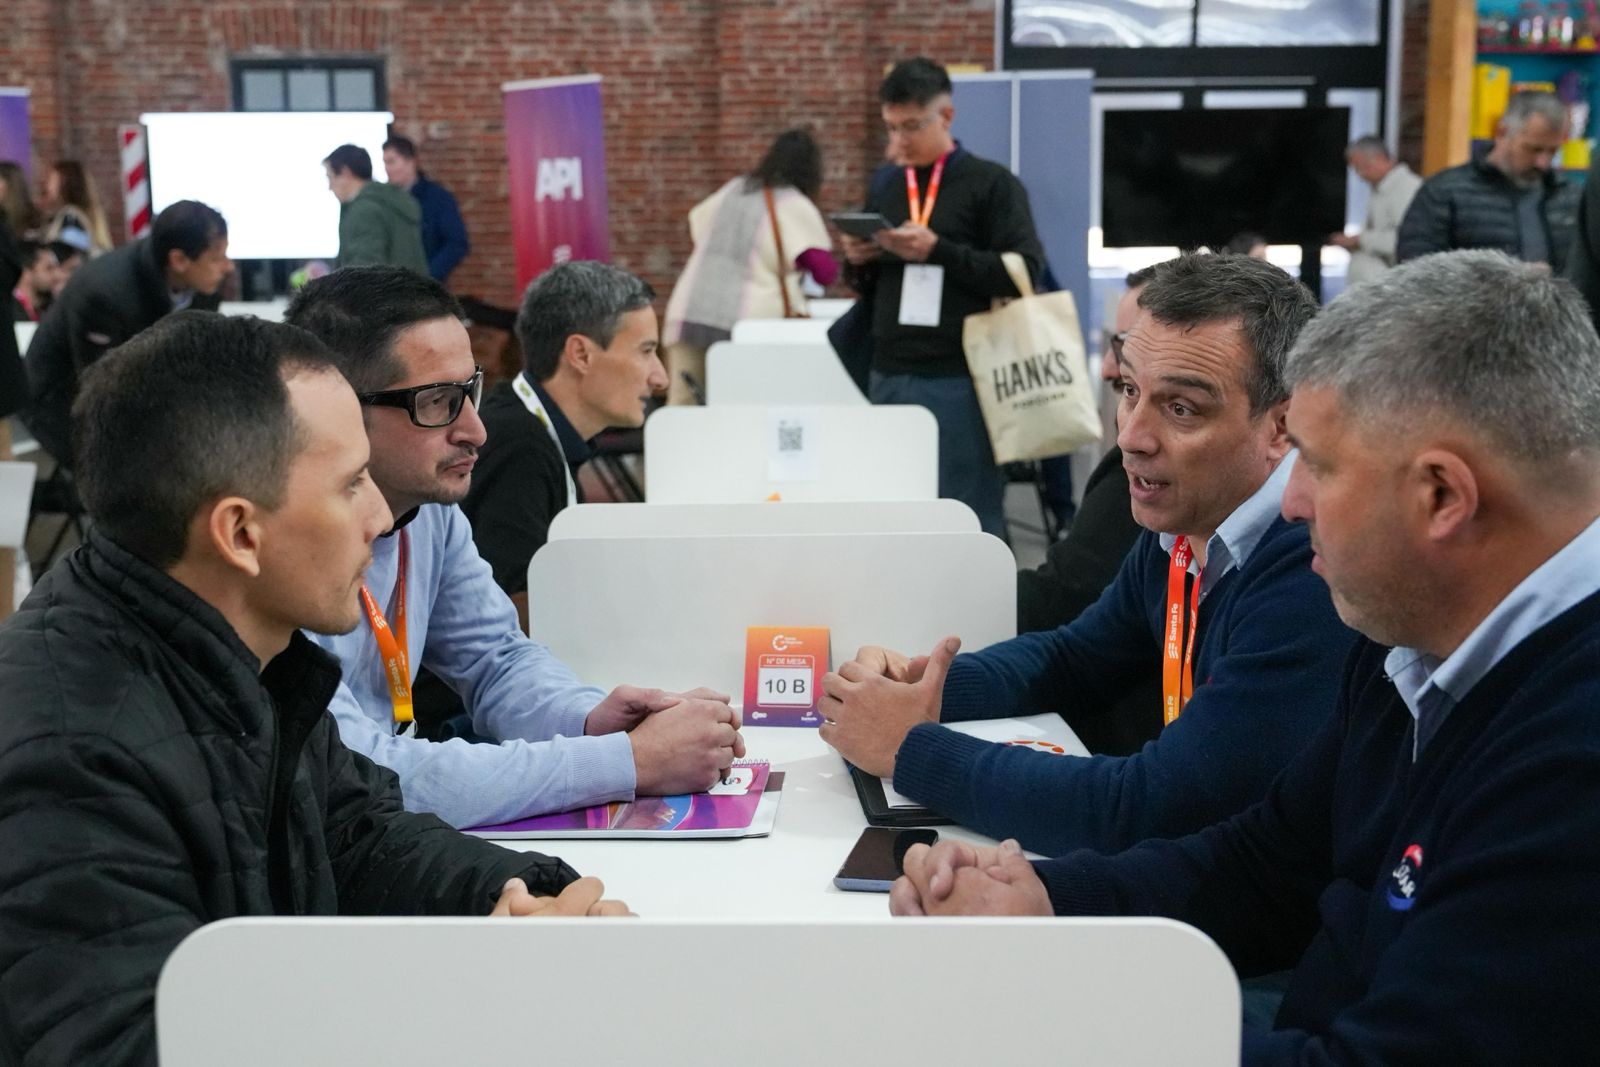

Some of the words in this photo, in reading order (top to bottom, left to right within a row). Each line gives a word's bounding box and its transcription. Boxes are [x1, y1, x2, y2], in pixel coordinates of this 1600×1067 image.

[534, 157, 583, 202] API
[1171, 603, 1179, 614] Fe
[1169, 614, 1178, 641] Santa
[776, 657, 785, 665] DE
[786, 657, 806, 665] MESA
[765, 679, 786, 694] 10
[793, 679, 805, 694] B
[1167, 695, 1174, 706] Fe
